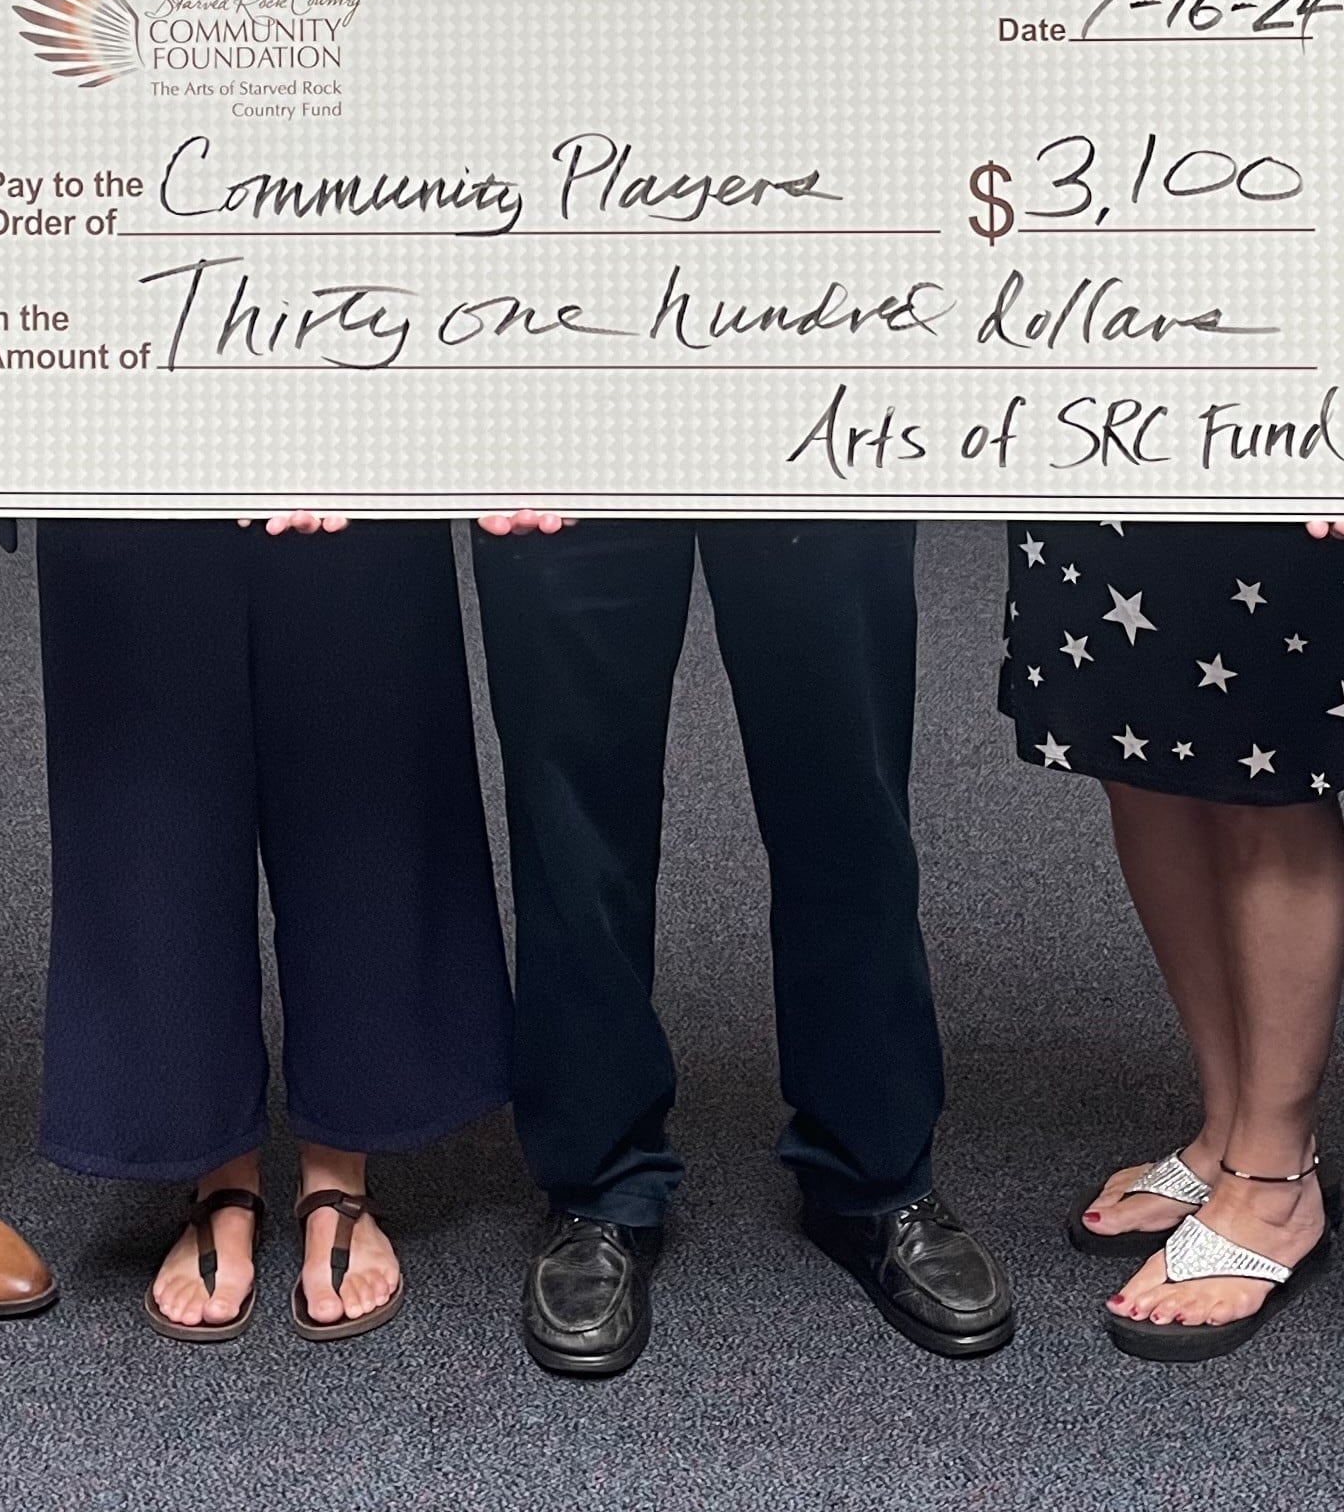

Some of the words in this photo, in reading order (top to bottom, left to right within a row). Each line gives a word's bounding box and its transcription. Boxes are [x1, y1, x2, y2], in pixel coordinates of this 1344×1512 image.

[149, 18, 342, 44] COMMUNITY
[998, 17, 1066, 42] Date
[153, 45, 341, 70] FOUNDATION
[151, 81, 180, 96] The
[184, 81, 214, 96] Arts
[219, 80, 236, 95] of
[239, 80, 297, 96] Starved
[302, 80, 342, 95] Rock
[231, 103, 296, 121] Country
[302, 102, 342, 117] Fund
[53, 171, 84, 197] to
[93, 170, 144, 197] the
[160, 135, 523, 237] Community
[552, 132, 843, 222] Players
[85, 208, 118, 235] of
[20, 304, 69, 331] the
[138, 256, 419, 372] Thirty
[438, 295, 639, 345] one
[650, 265, 957, 349] hundred
[977, 269, 1280, 350] dollars
[119, 342, 151, 369] of
[786, 385, 926, 479] Arts
[962, 396, 1026, 468] of
[1051, 395, 1171, 470] SRC
